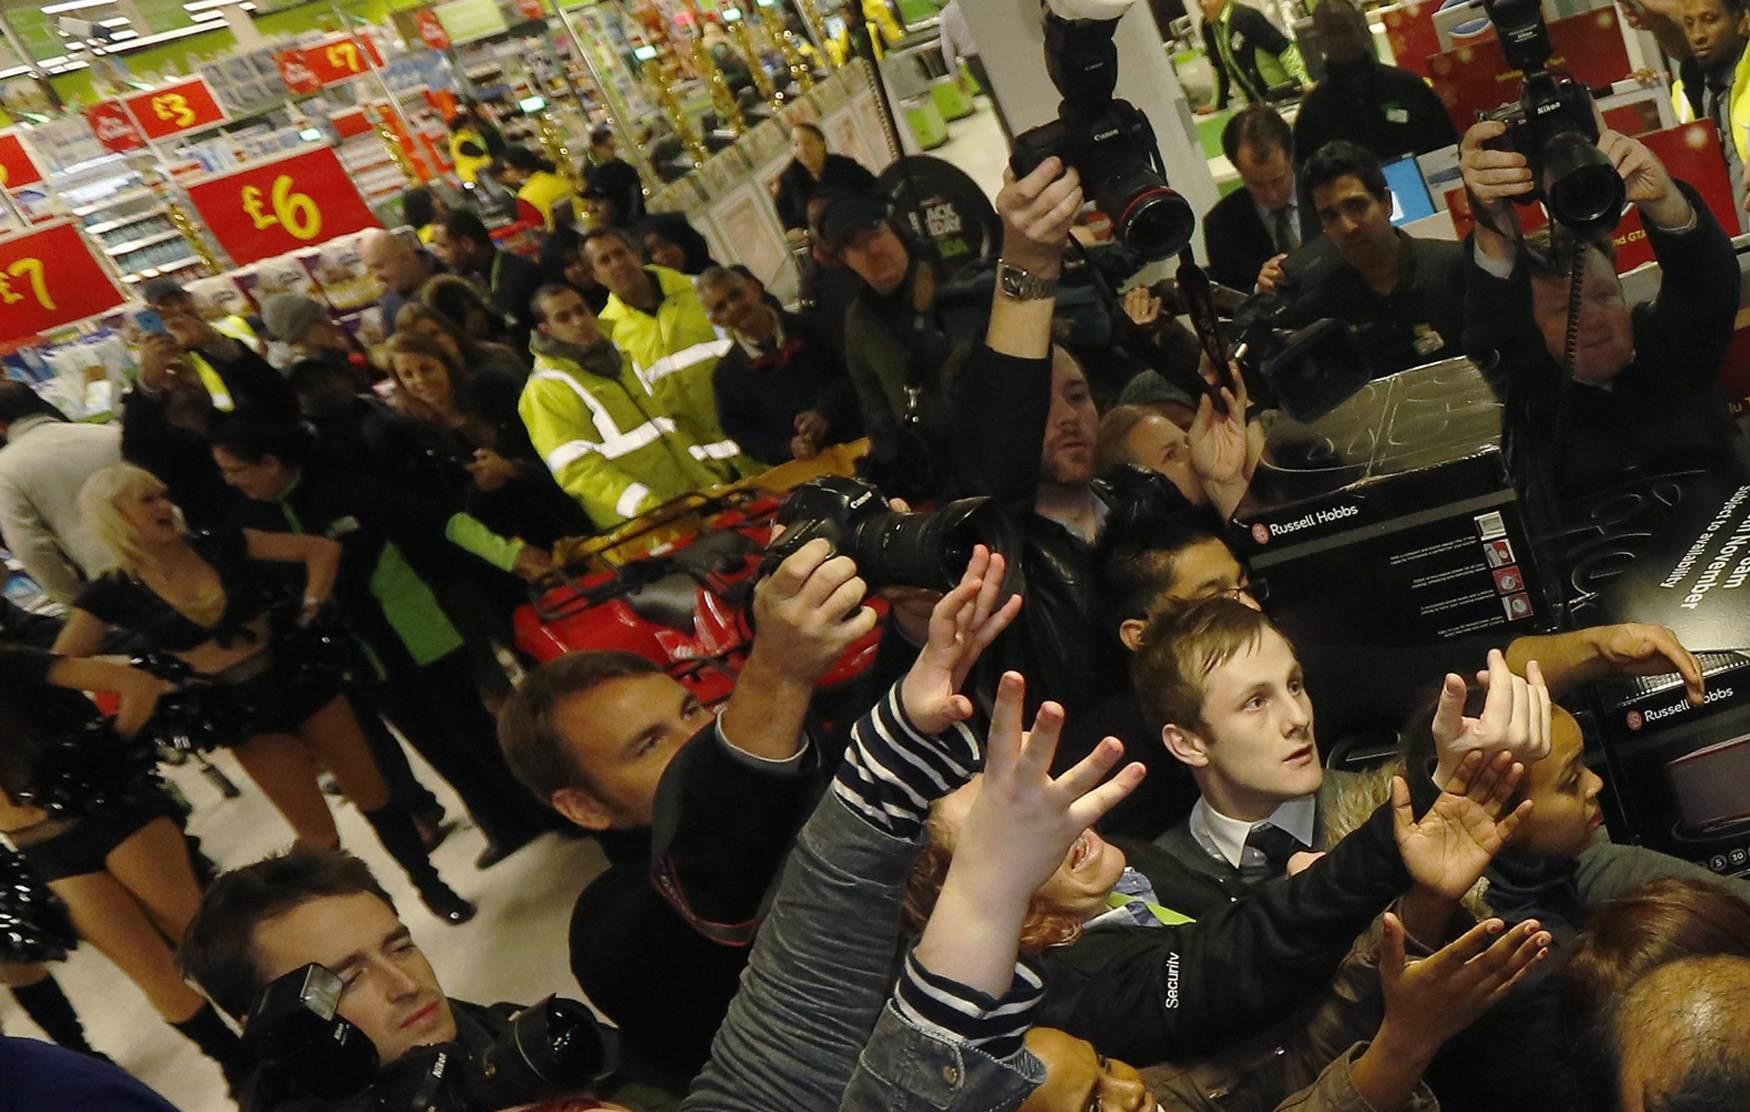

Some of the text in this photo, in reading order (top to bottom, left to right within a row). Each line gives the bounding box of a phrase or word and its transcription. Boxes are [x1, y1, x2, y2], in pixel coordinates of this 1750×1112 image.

[151, 92, 195, 127] £3
[1537, 102, 1560, 115] Nikon
[241, 174, 322, 240] £6
[1728, 401, 1743, 413] lu
[1269, 503, 1359, 538] Russell Hobbs
[1707, 515, 1727, 532] to
[1660, 532, 1713, 588] availability
[1644, 686, 1734, 724] Russell obbs
[1165, 951, 1180, 1010] Security
[432, 1052, 448, 1079] Nikon
